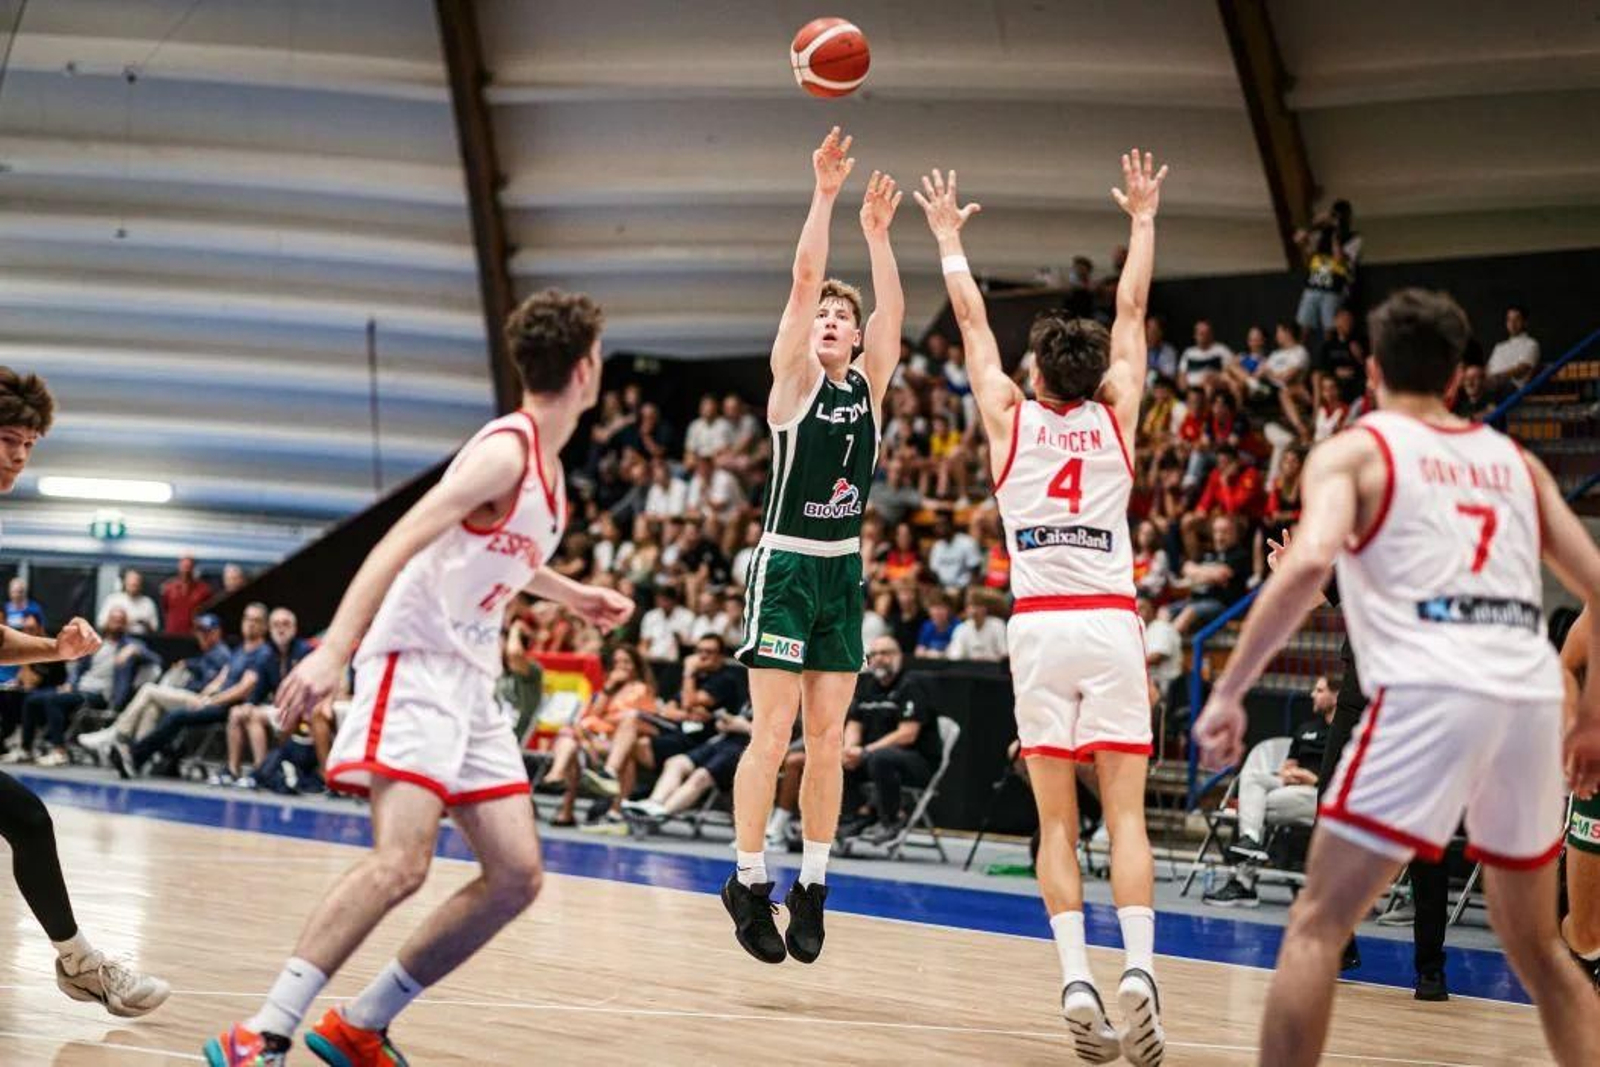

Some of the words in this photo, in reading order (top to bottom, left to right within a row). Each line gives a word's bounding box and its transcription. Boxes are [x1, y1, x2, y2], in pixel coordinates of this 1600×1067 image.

[842, 434, 854, 467] 7
[1047, 457, 1083, 514] 4
[1034, 527, 1110, 550] CaixaBank
[1456, 503, 1497, 575] 7
